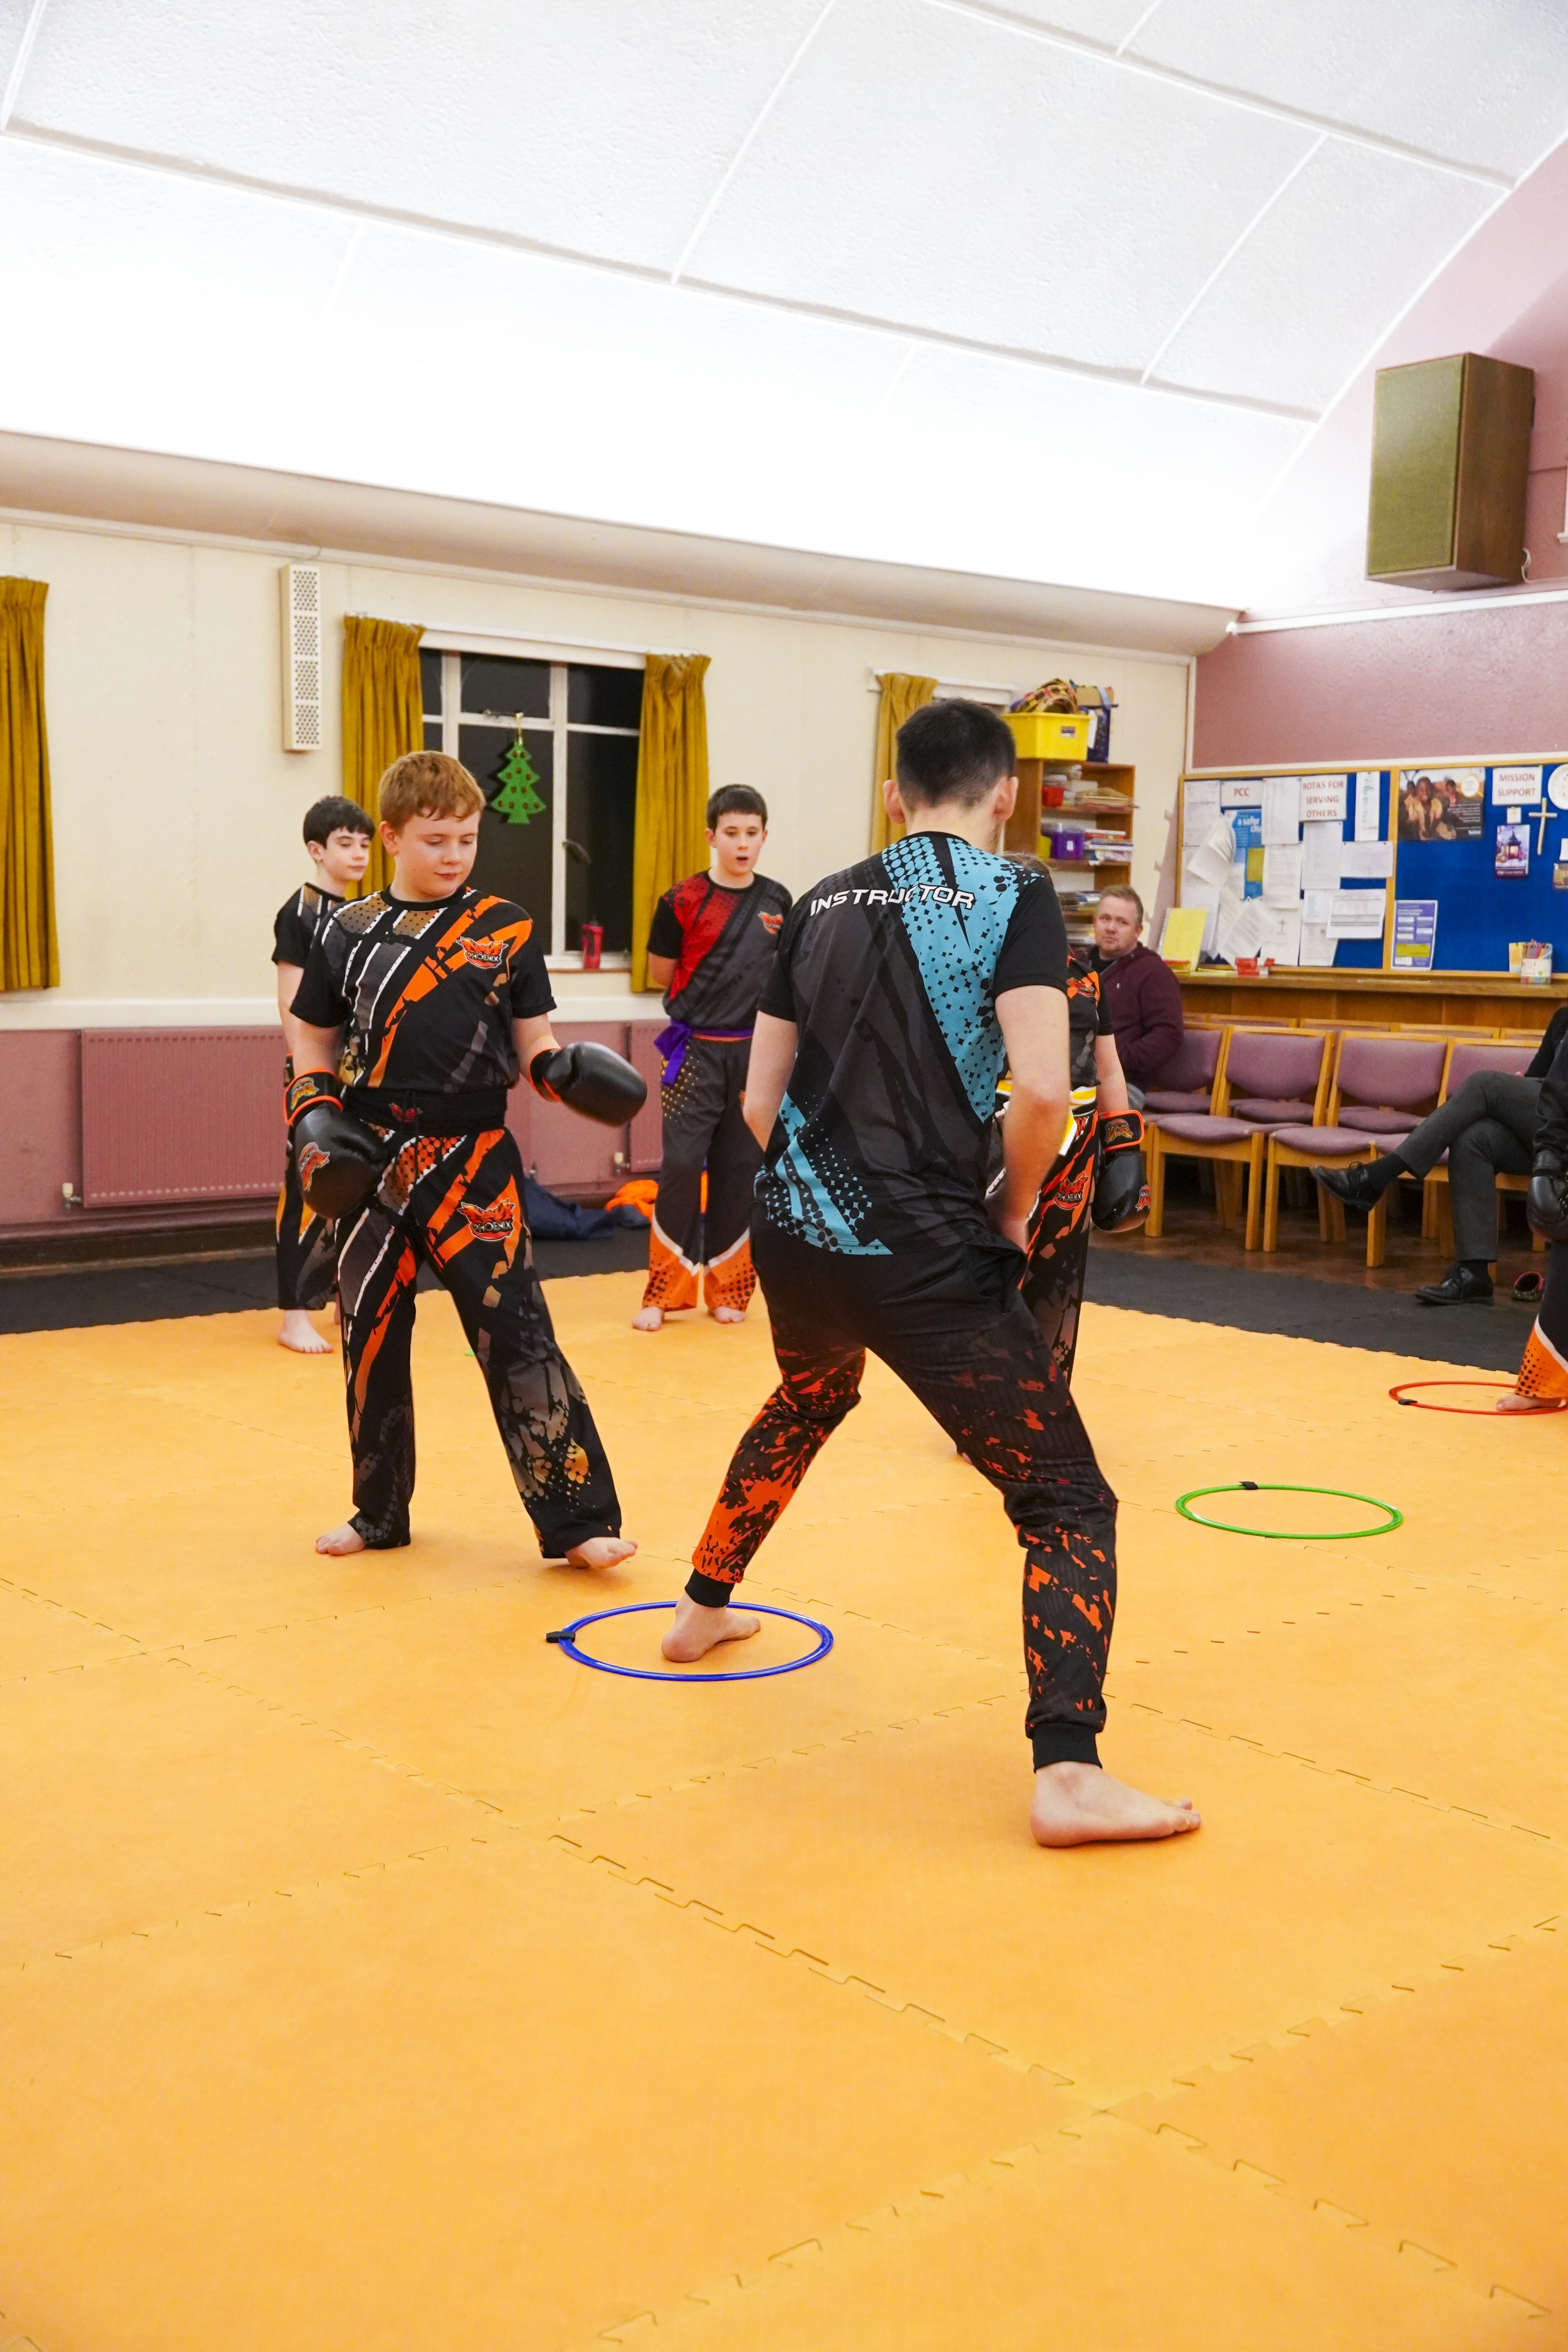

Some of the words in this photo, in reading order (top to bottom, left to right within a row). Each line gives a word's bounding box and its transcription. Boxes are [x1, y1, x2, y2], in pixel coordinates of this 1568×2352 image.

[1500, 773, 1535, 782] MISSION
[1303, 782, 1325, 790] ROTAS
[1233, 787, 1250, 797] PCC
[1498, 788, 1536, 797] SUPPORT
[1306, 795, 1339, 804] SERVING
[1306, 809, 1337, 818] OTHERS
[810, 884, 975, 916] INSTRUCTOR
[468, 952, 499, 962] PHOENIX
[1057, 1192, 1082, 1201] PHOENIX
[473, 1220, 512, 1232] PHOENIX
